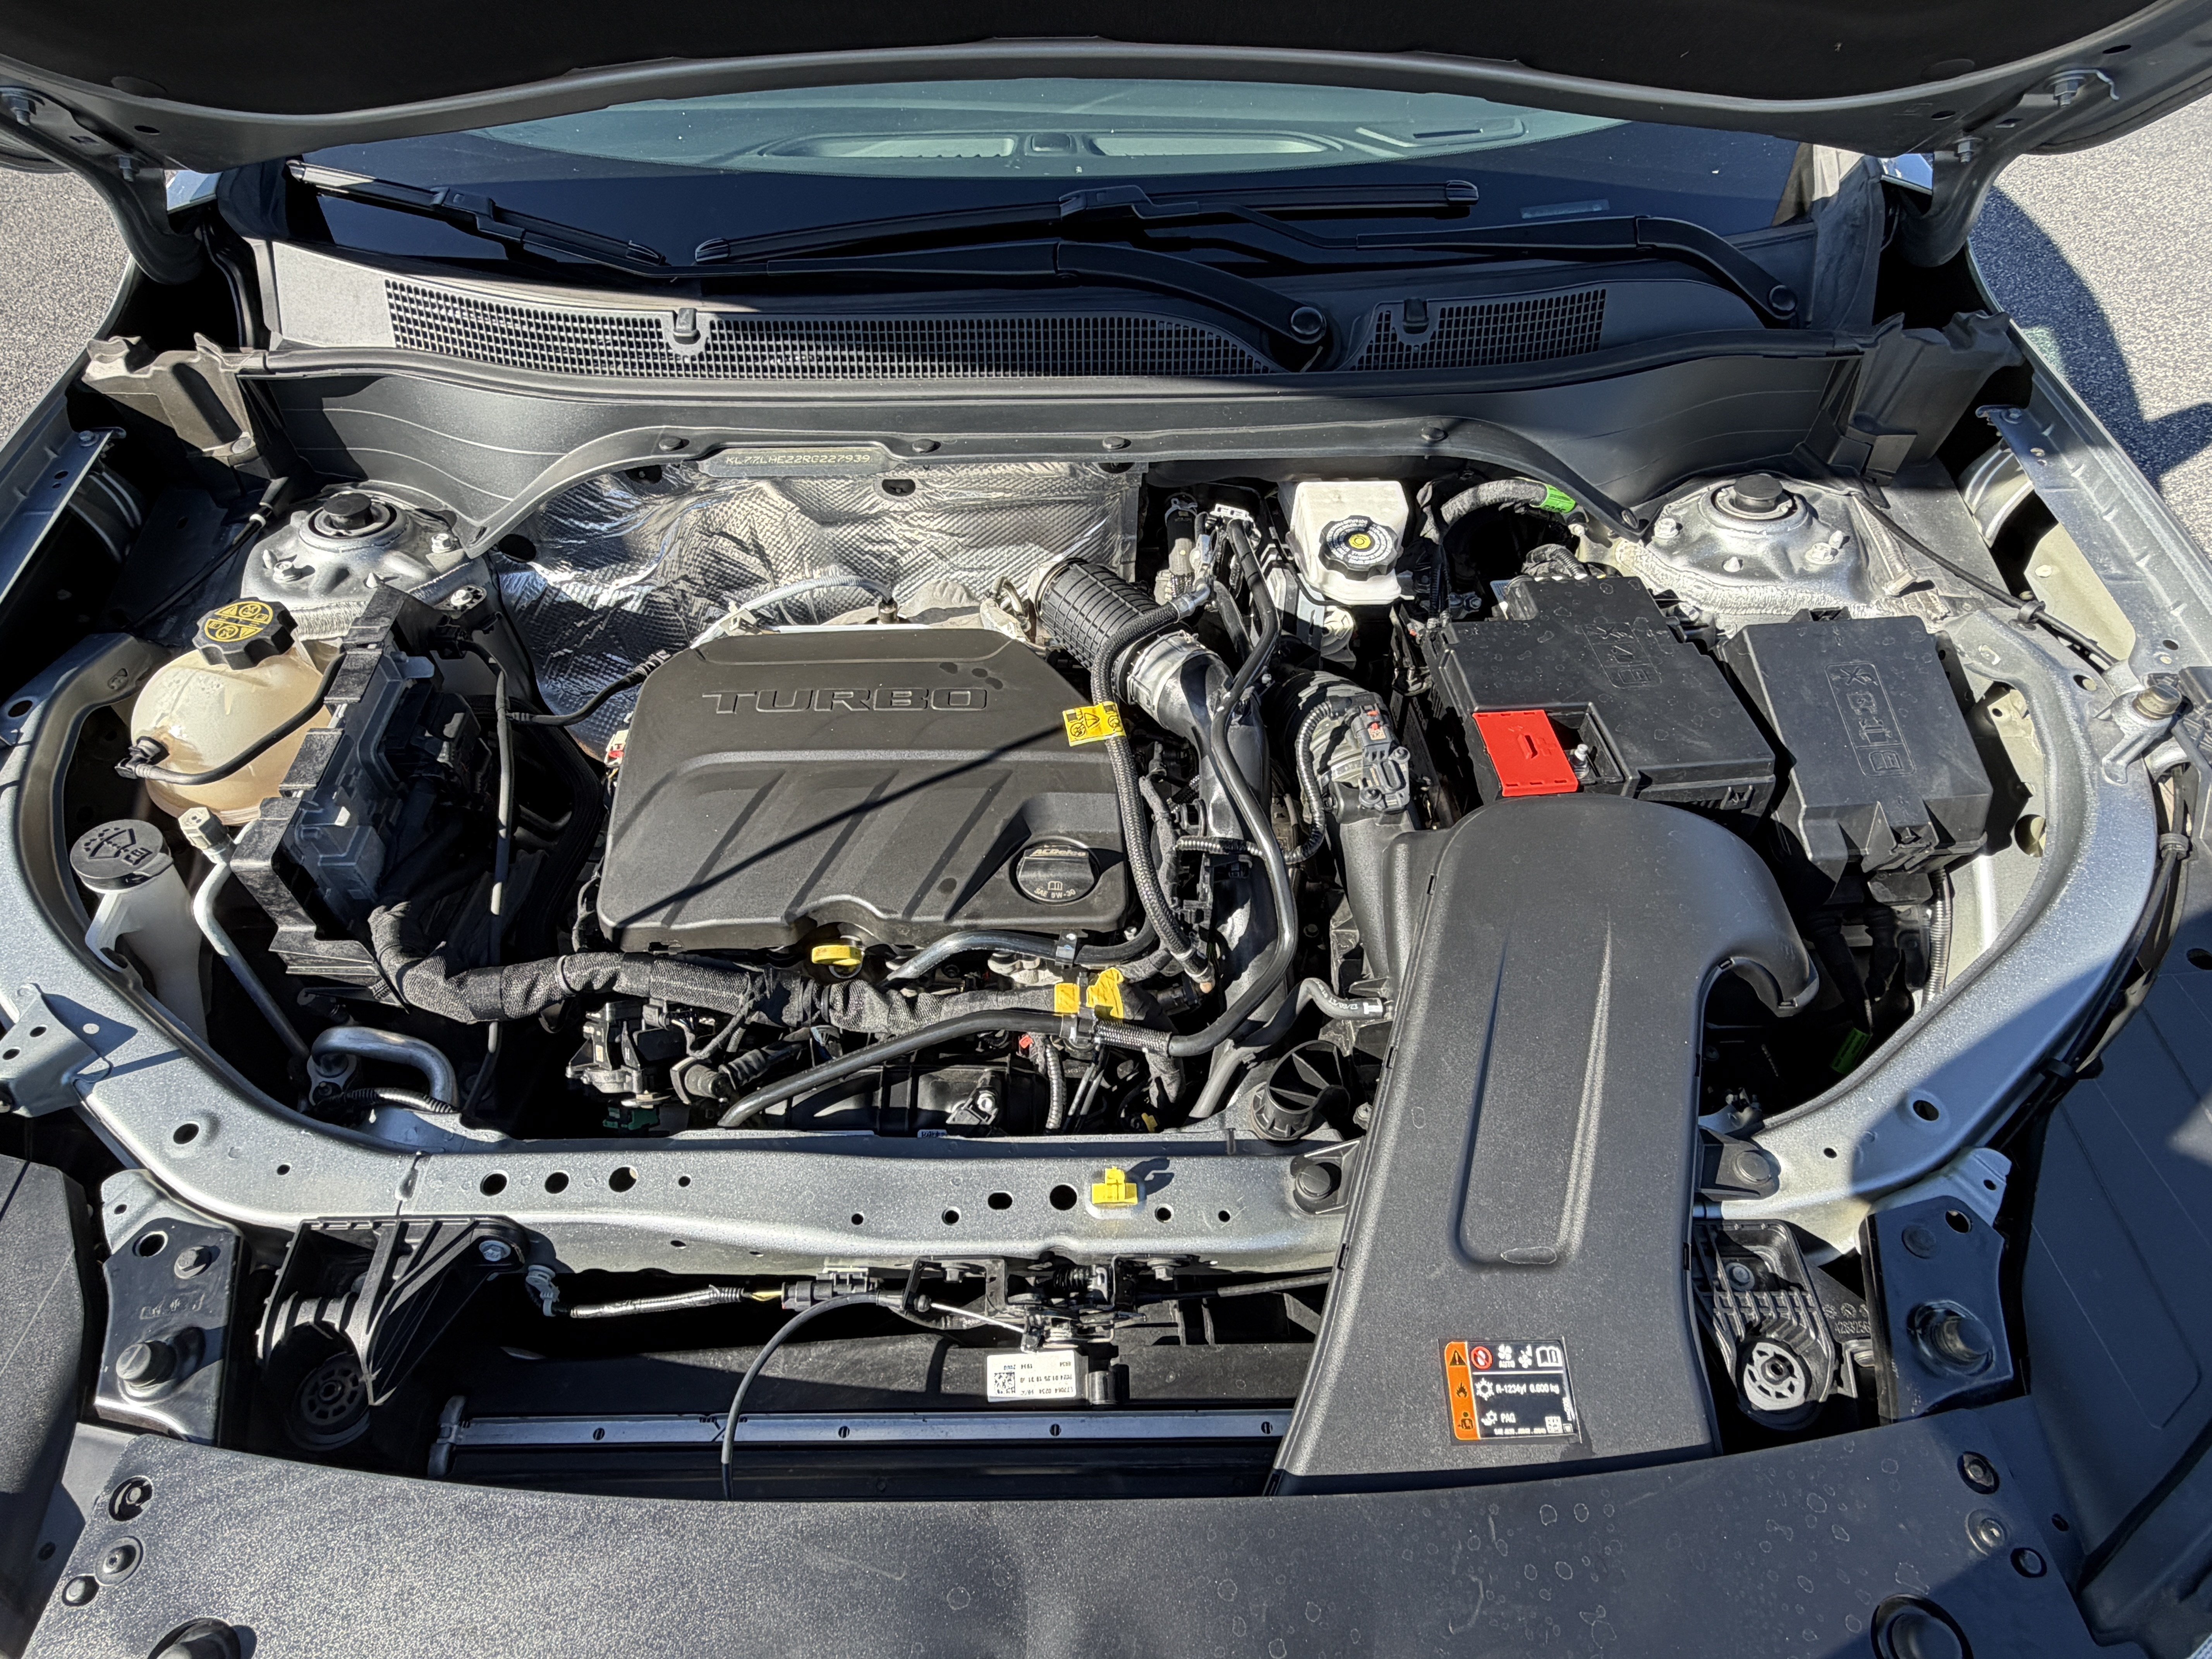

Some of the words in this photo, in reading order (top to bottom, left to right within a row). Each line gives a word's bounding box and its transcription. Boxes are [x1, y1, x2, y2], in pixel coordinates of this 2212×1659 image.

[702, 688, 987, 714] TURBO
[1034, 888, 1048, 897] SAE
[1051, 889, 1076, 898] 5W-30
[1550, 1383, 1560, 1394] kg
